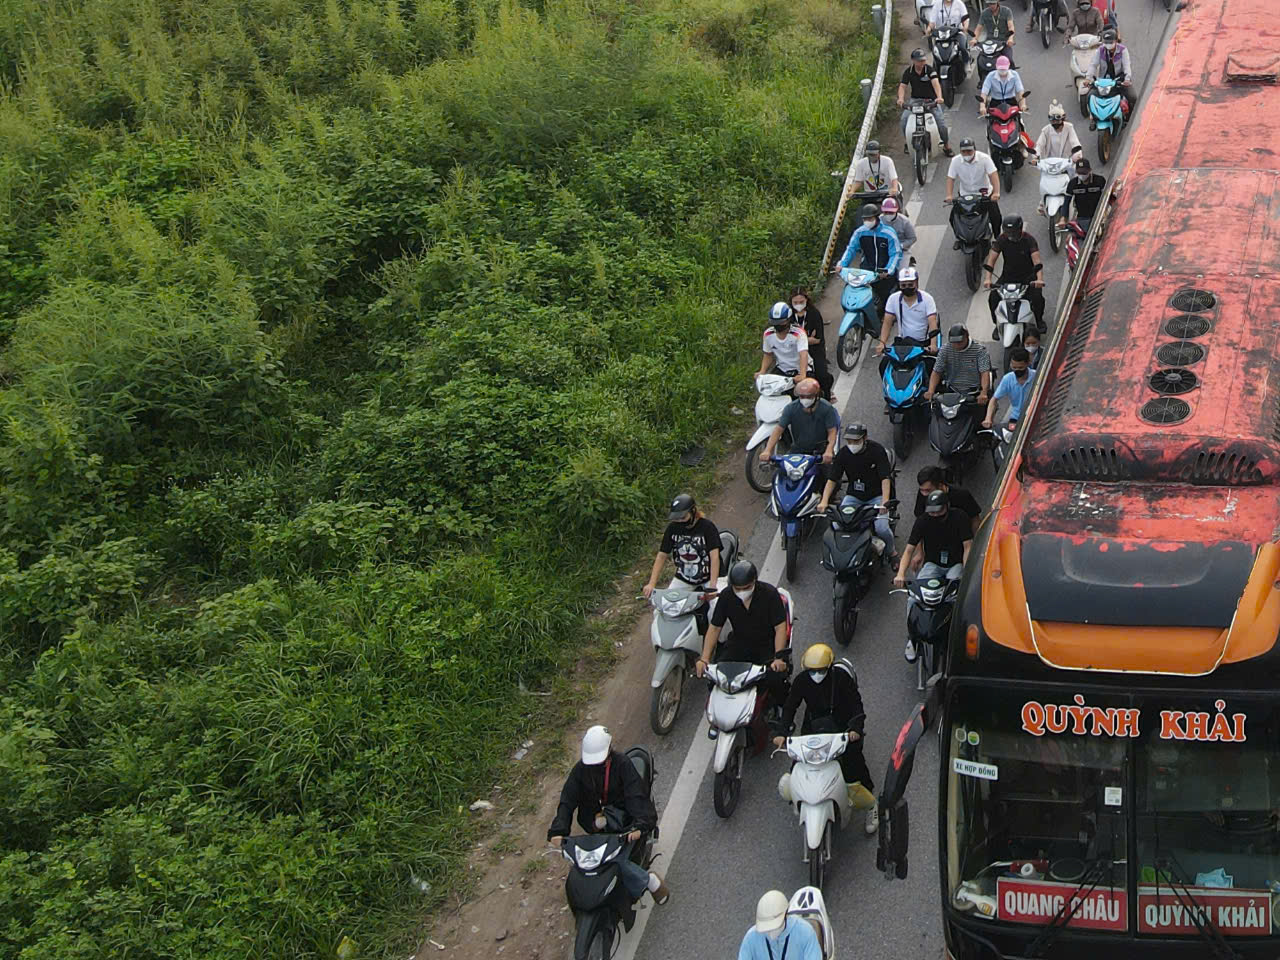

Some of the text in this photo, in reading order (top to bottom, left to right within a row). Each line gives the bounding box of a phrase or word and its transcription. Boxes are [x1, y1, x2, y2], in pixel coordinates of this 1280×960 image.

[1021, 694, 1247, 742] QUỲNH KHẢI
[1004, 890, 1120, 922] QUANG CHÂU
[1145, 899, 1265, 928] QUỲNH KHẢI
